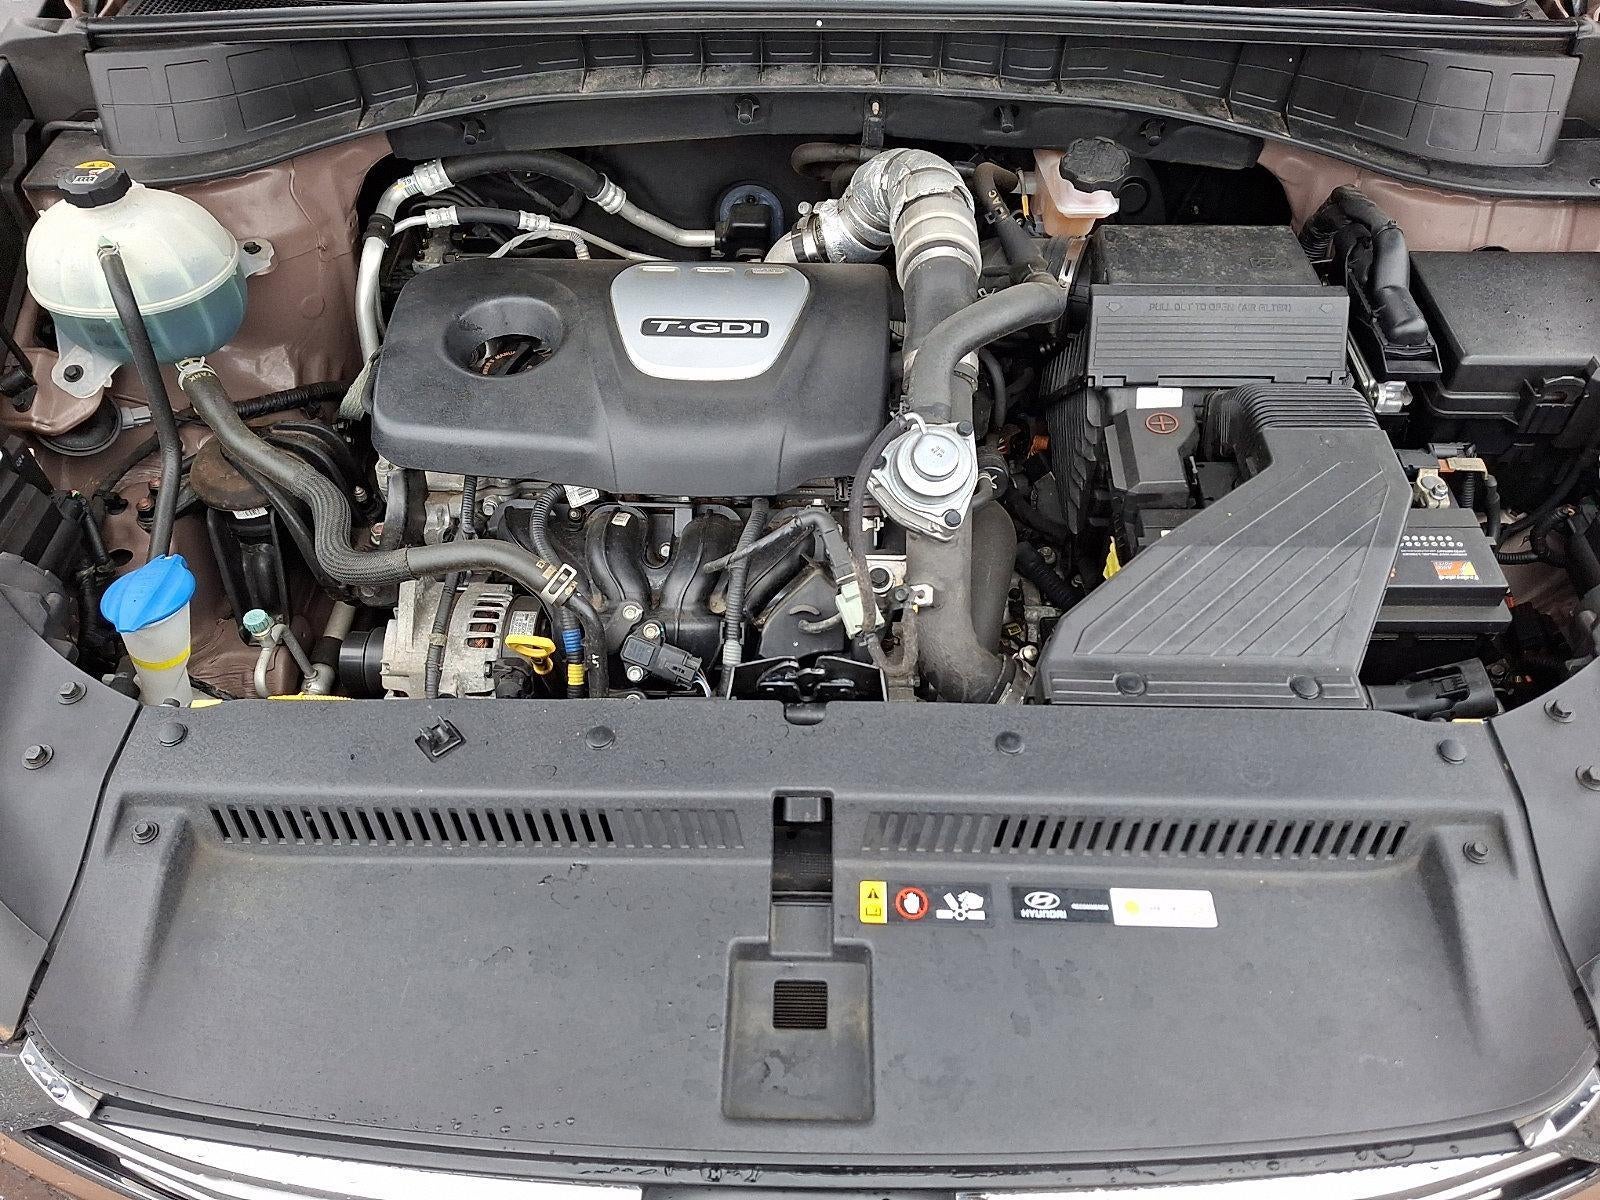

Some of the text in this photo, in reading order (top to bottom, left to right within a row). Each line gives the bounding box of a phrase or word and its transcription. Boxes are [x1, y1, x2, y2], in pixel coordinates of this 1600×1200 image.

[1149, 303, 1171, 312] PULL
[1174, 303, 1192, 312] OUT
[1195, 303, 1207, 312] TO
[1209, 303, 1234, 312] OPEN
[650, 320, 762, 334] T-GDI
[1020, 909, 1067, 919] HYUNDAI
